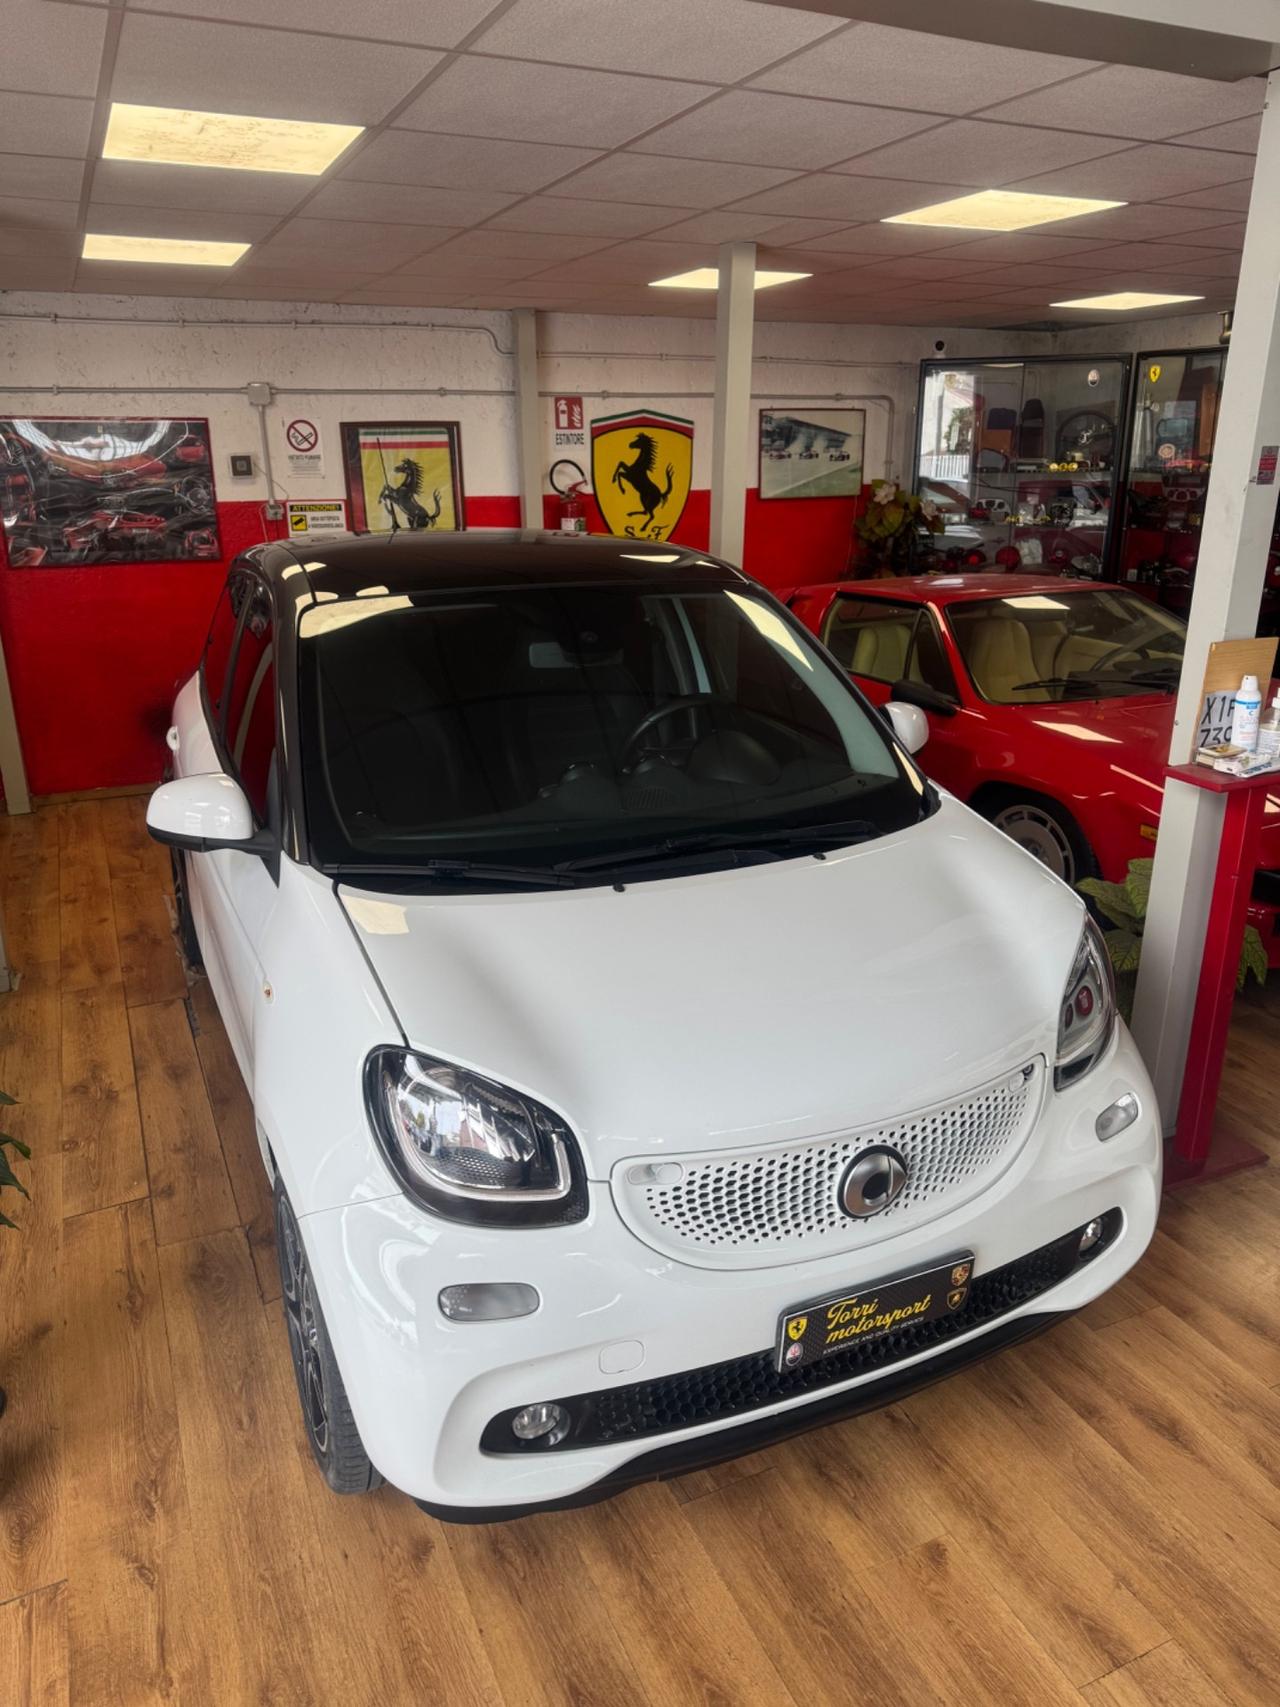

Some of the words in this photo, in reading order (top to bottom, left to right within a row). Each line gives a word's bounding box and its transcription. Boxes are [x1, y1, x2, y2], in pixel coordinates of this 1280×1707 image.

[556, 433, 585, 446] ESTINTORE
[825, 1294, 931, 1344] motorsport
[827, 1297, 879, 1329] Torri
